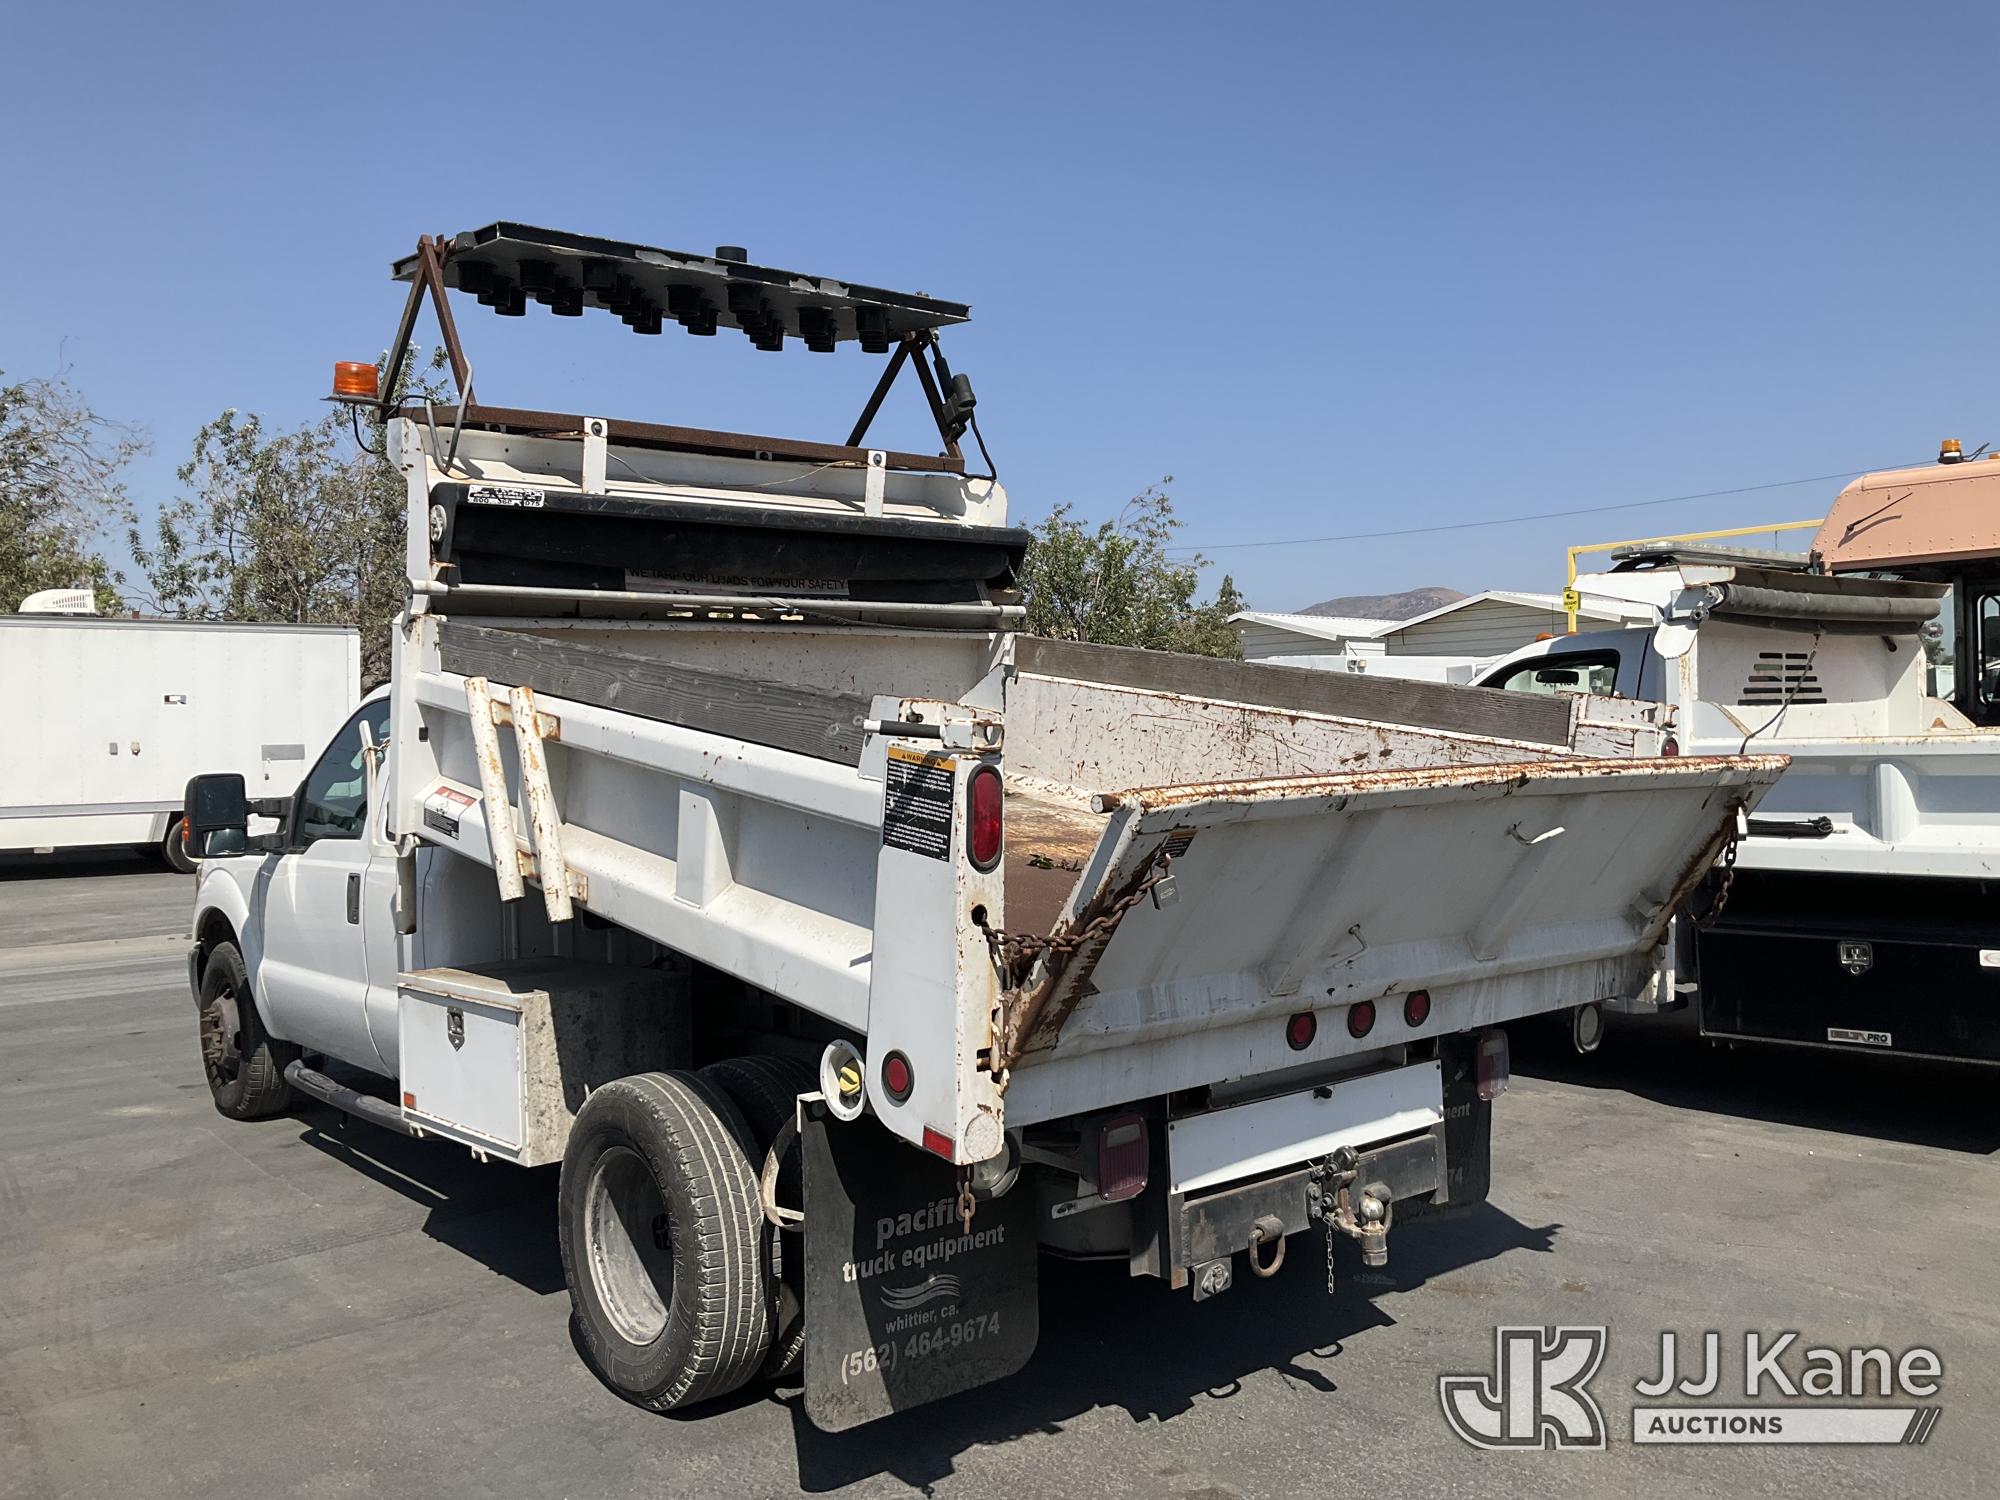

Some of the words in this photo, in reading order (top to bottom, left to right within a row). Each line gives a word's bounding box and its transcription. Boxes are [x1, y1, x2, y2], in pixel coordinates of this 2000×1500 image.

[774, 577, 805, 589] YOUR
[807, 578, 845, 590] SAFETY
[1867, 1033, 1888, 1043] PRO
[842, 1251, 895, 1283] truck
[902, 1223, 1005, 1268] equipment
[885, 1309, 938, 1335] whittier,
[940, 1303, 960, 1318] ca.
[841, 1340, 898, 1385] (562)
[904, 1311, 1001, 1359] 464-9674
